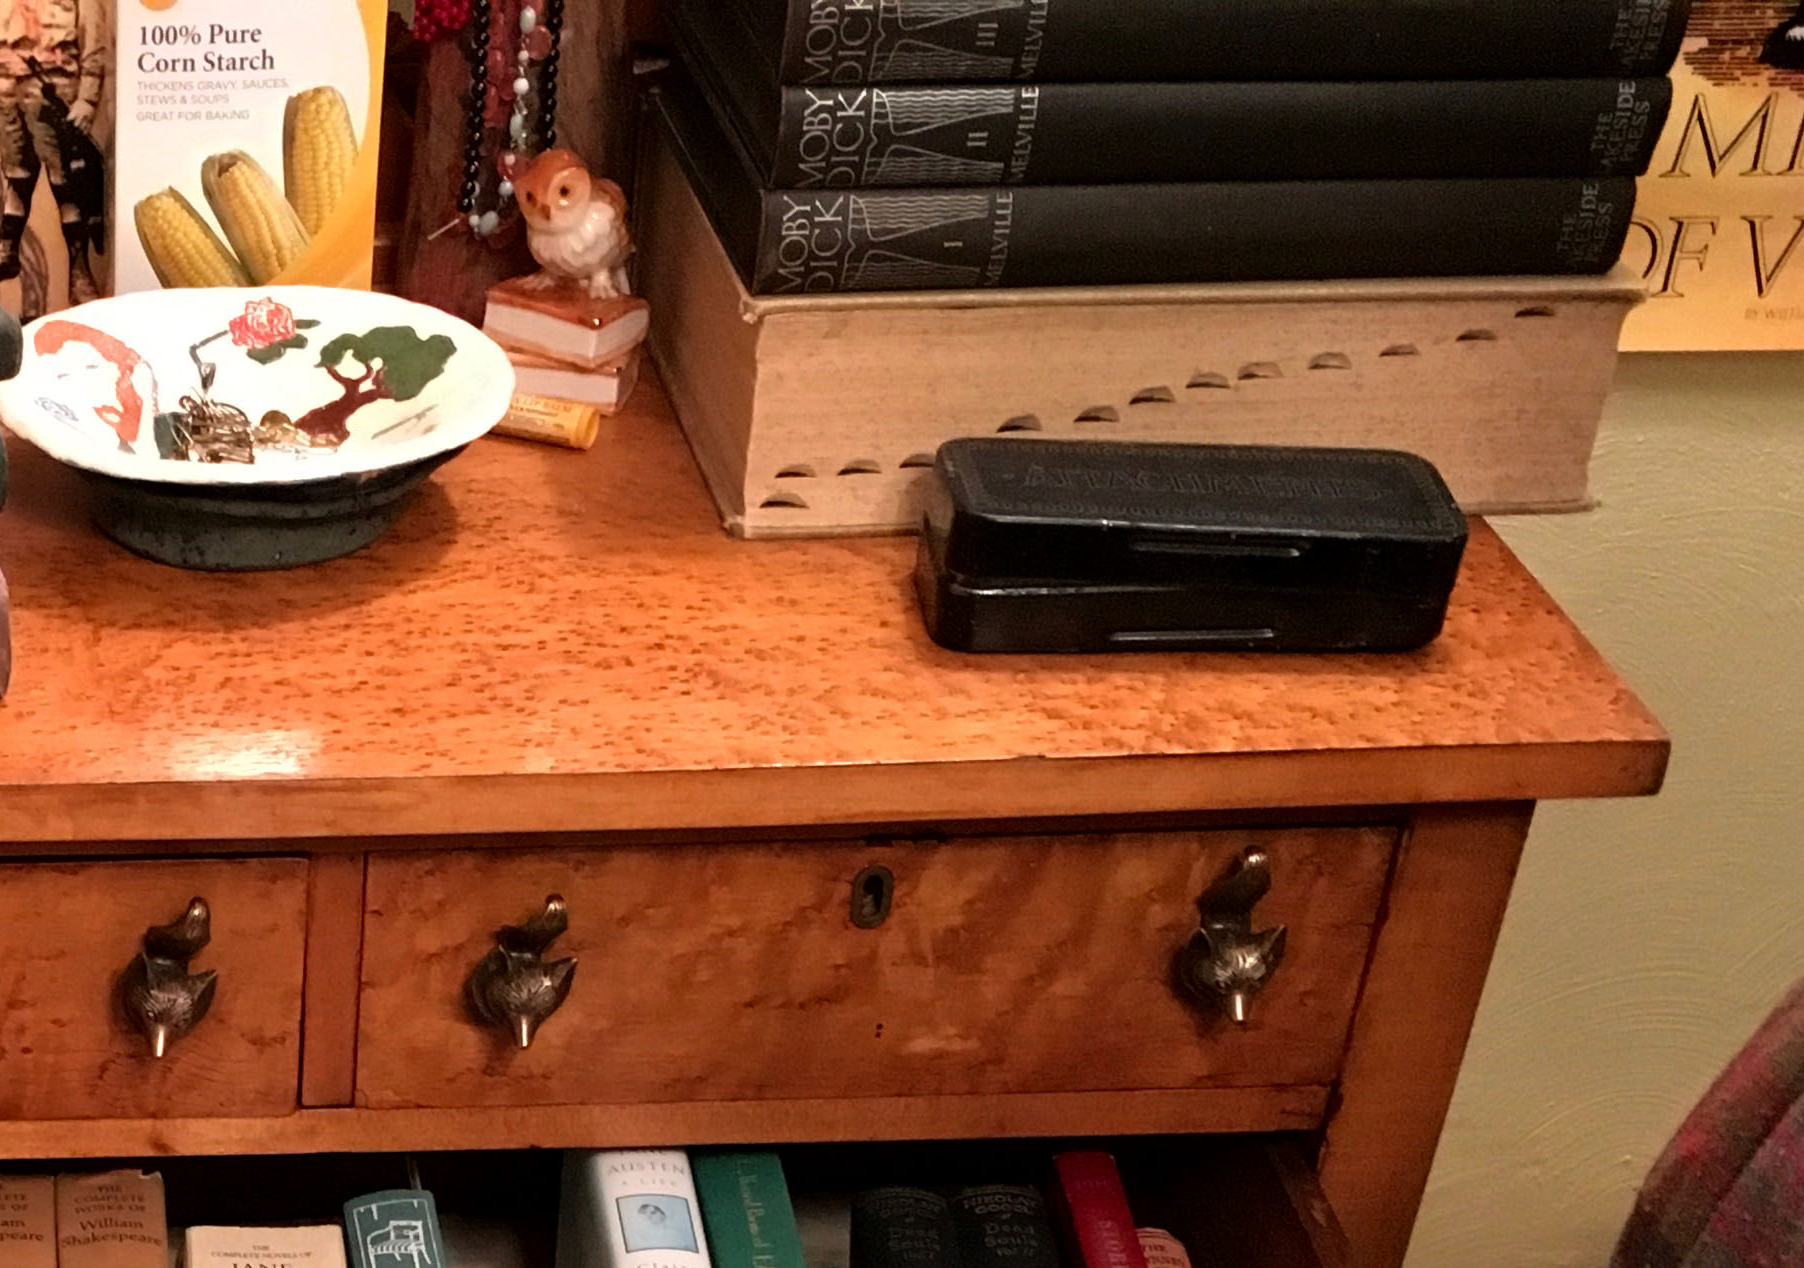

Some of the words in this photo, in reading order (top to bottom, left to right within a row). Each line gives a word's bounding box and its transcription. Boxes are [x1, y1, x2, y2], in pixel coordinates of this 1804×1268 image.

[140, 25, 201, 46] 100%
[208, 23, 262, 45] Pure
[803, 0, 839, 83] MOB
[1020, 0, 1047, 79] MELVIL
[137, 52, 196, 73] Corn
[202, 48, 275, 72] Starch
[136, 95, 177, 106] STEWS
[191, 94, 230, 105] SOUPS
[137, 81, 194, 92] THICKENS
[136, 111, 174, 122] GREAT
[178, 110, 202, 121] FOR
[206, 109, 250, 121] BAKING
[798, 88, 834, 187] MOBY
[826, 88, 867, 186] DICK
[966, 131, 989, 147] II
[1010, 86, 1039, 181] MELVILLE
[1589, 112, 1612, 153] THE
[776, 194, 811, 292] MOBY
[804, 194, 844, 291] DICK
[986, 191, 1013, 286] MELVILLE
[608, 1162, 684, 1174] AUSTEN
[61, 1233, 163, 1248] Shakespeare
[79, 1217, 144, 1231] William
